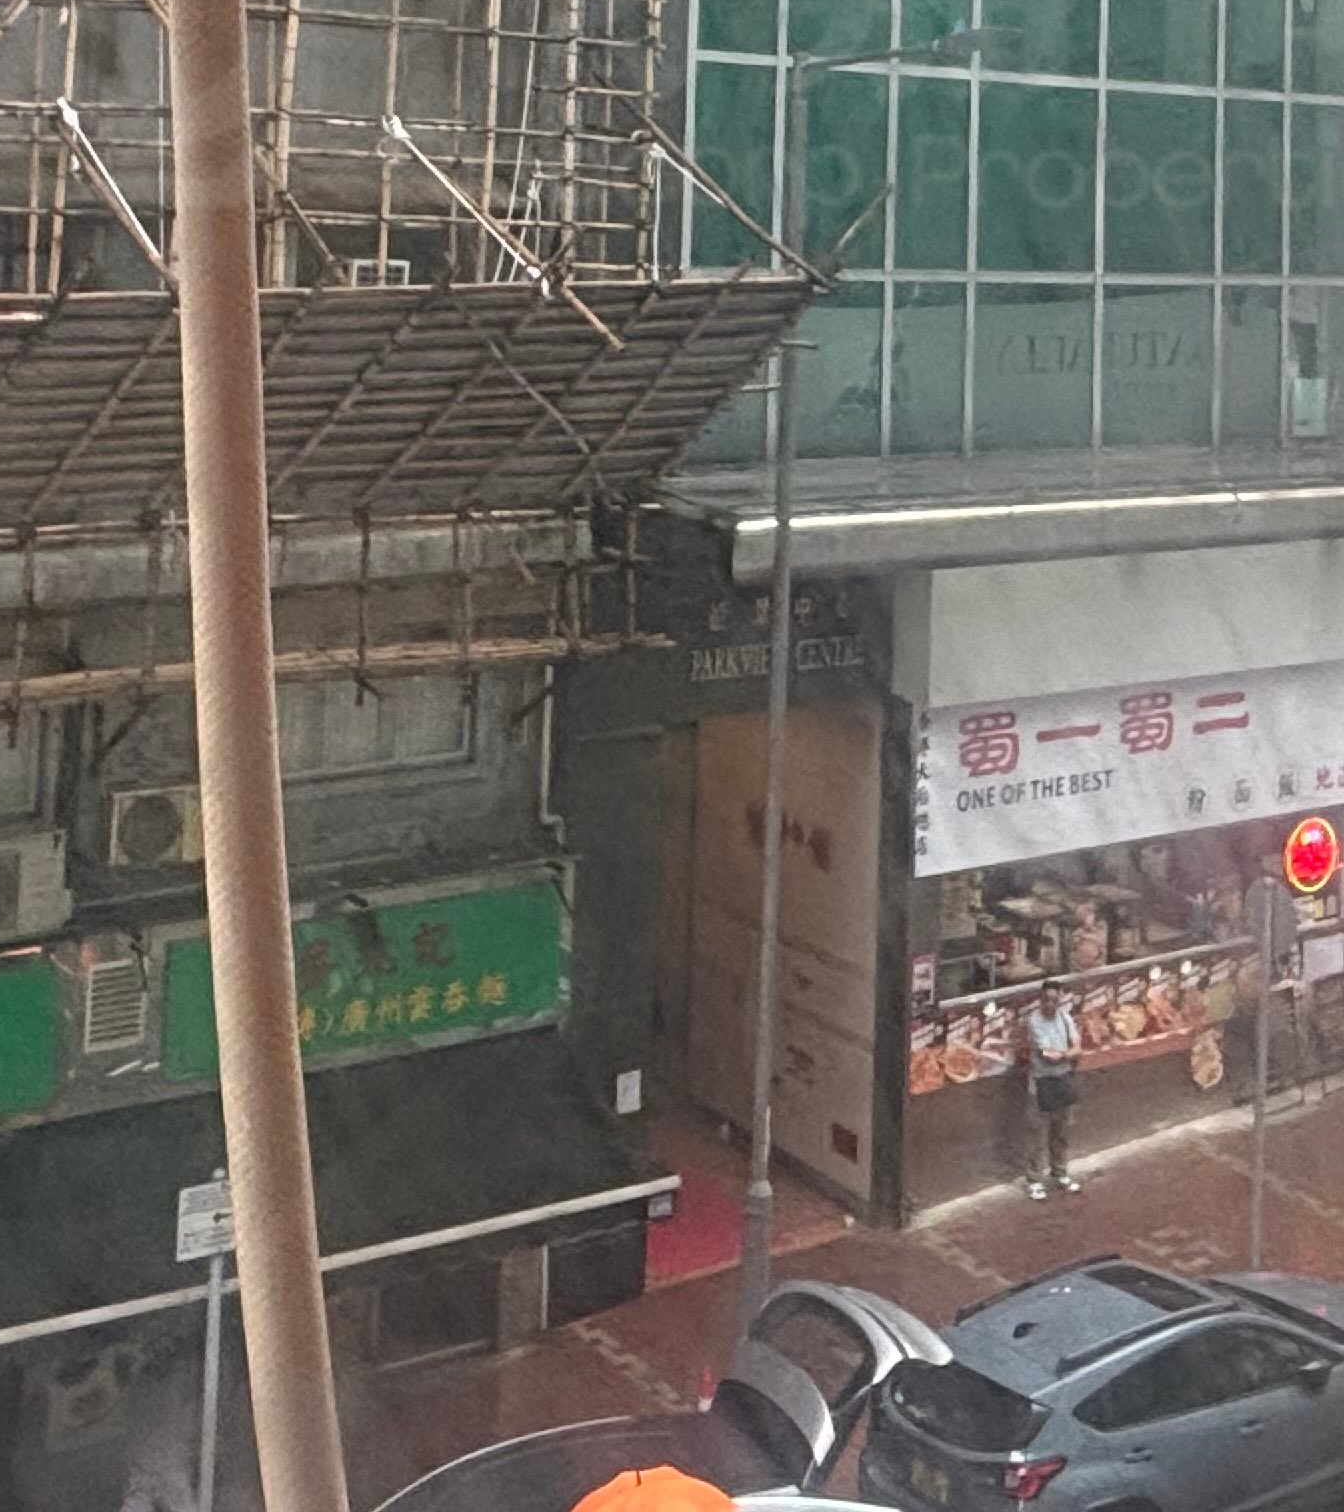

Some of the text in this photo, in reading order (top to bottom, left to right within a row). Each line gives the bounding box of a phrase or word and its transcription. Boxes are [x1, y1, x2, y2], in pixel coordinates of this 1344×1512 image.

[959, 691, 1250, 778] 蜀一蜀二
[957, 769, 1114, 812] ONE OF THE BEST
